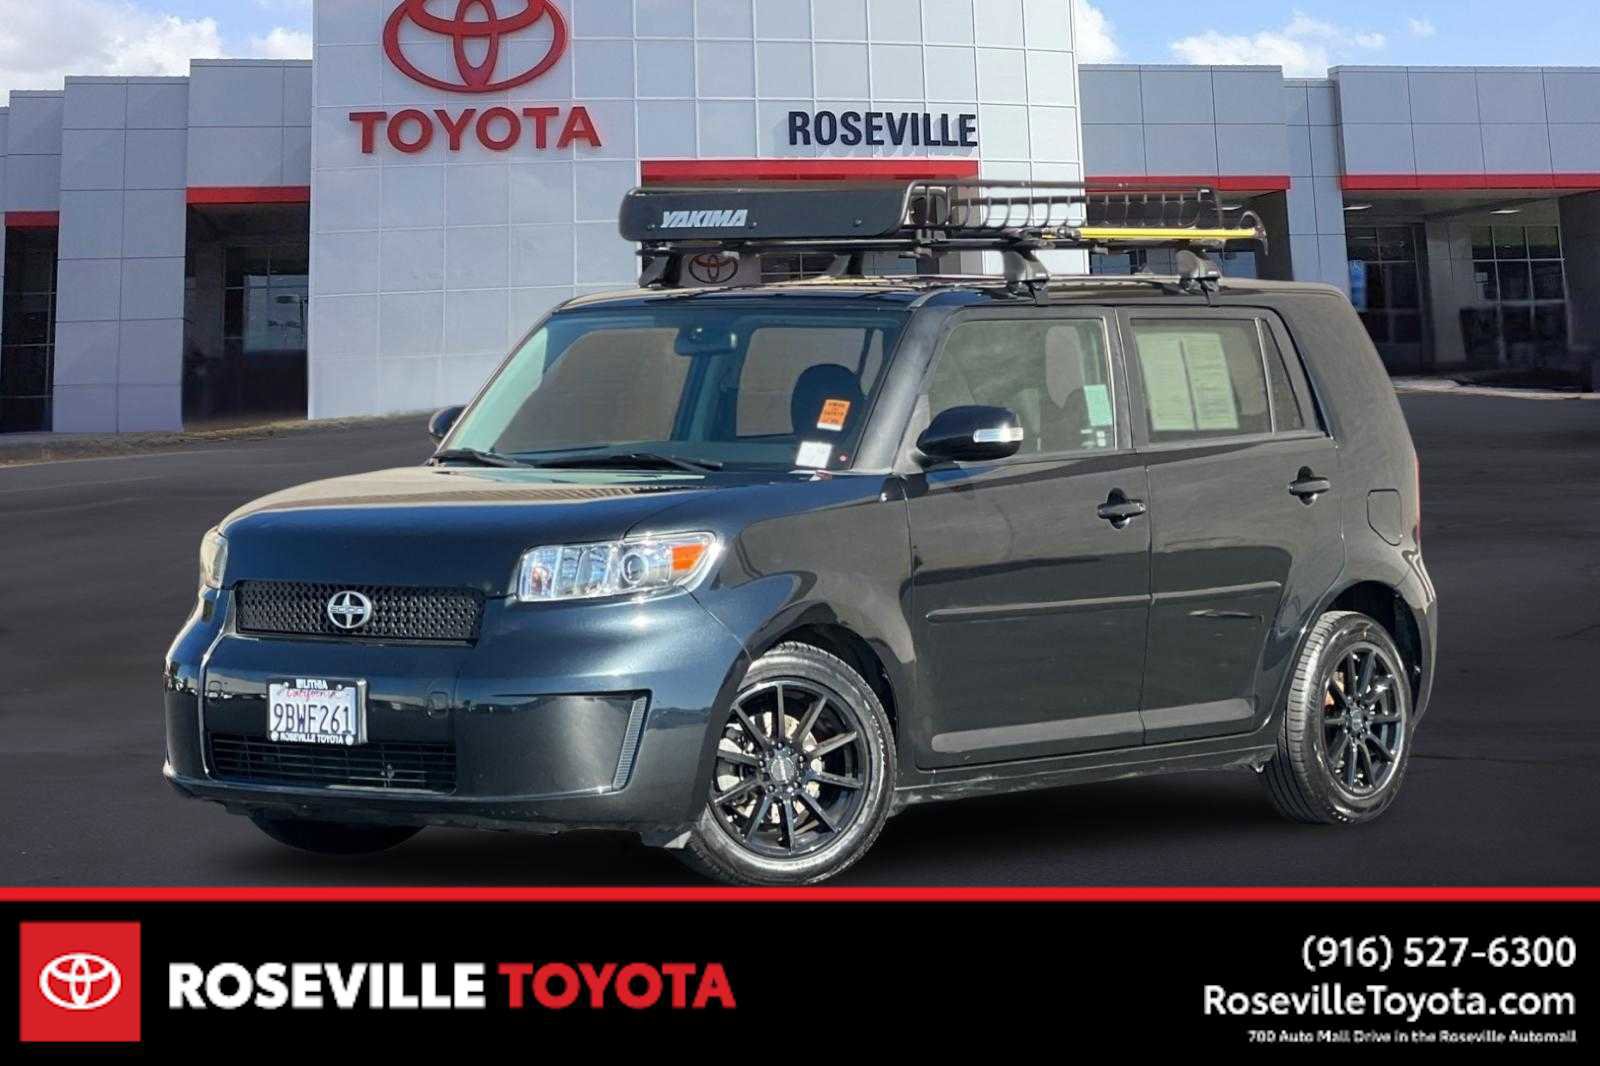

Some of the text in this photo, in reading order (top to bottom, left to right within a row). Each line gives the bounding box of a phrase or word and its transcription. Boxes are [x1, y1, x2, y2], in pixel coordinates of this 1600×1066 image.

[349, 106, 602, 154] TOYOTA
[788, 111, 978, 147] ROSEVILLE
[660, 209, 749, 229] YAKIMA
[273, 703, 352, 735] 9BWF261
[317, 734, 344, 745] TOYOTA
